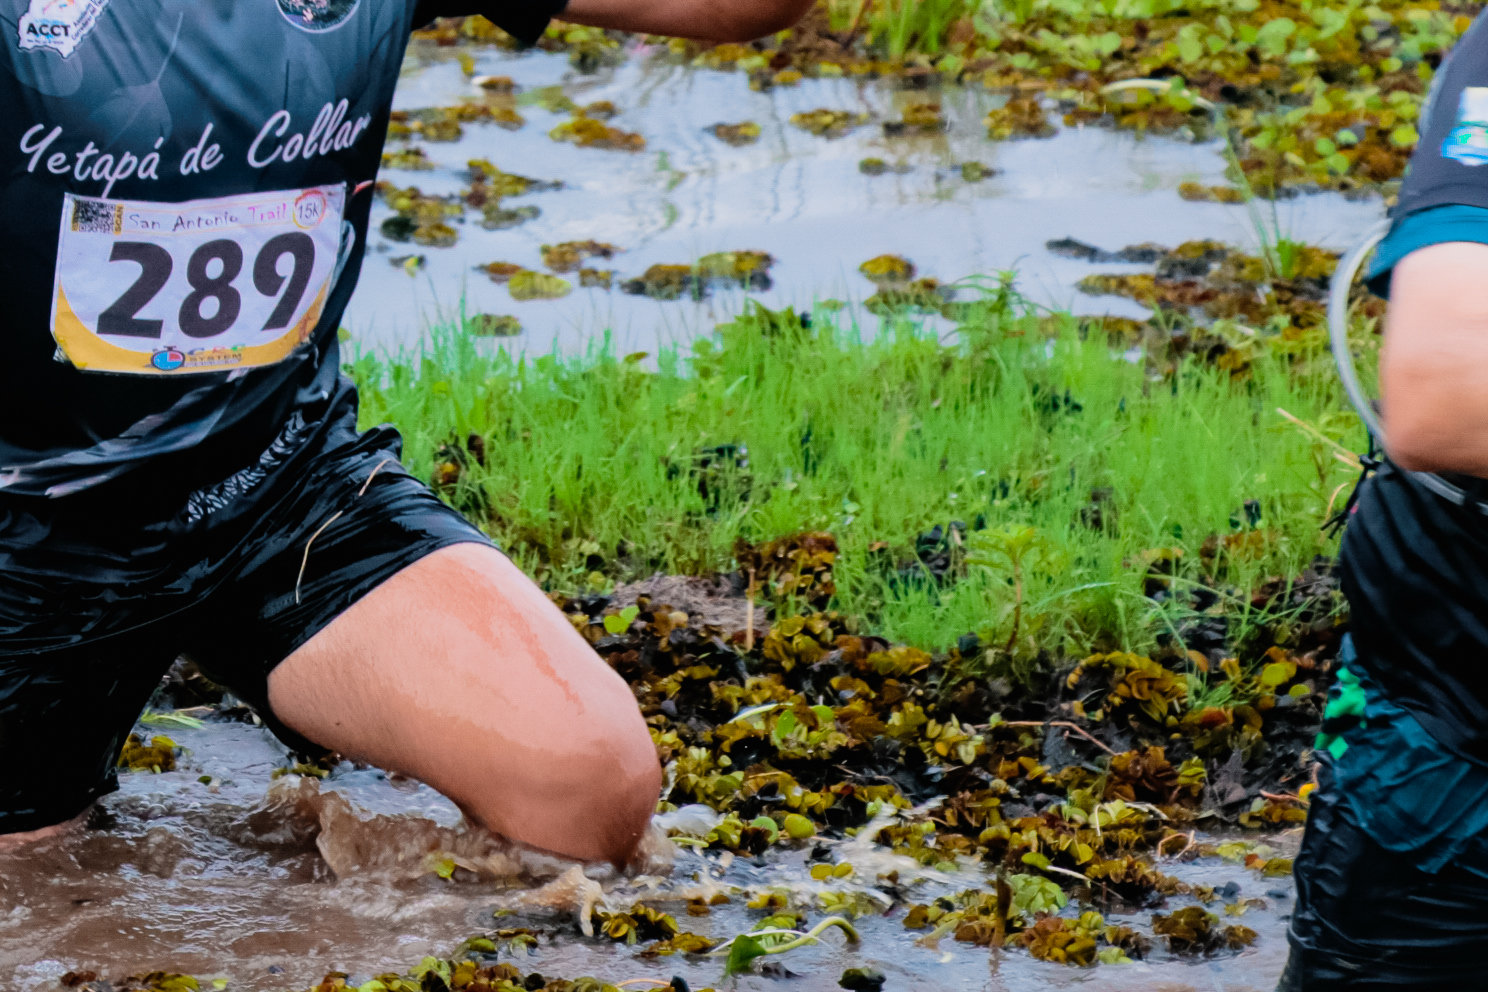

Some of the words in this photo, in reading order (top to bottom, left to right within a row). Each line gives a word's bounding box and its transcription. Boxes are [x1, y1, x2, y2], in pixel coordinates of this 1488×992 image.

[26, 23, 71, 37] ACCT
[19, 123, 165, 200] Yetapá
[179, 122, 225, 176] de
[247, 97, 372, 169] Collar
[129, 213, 161, 229] San
[172, 211, 239, 232] Antonio
[247, 203, 287, 222] Trail
[96, 231, 316, 340] 289
